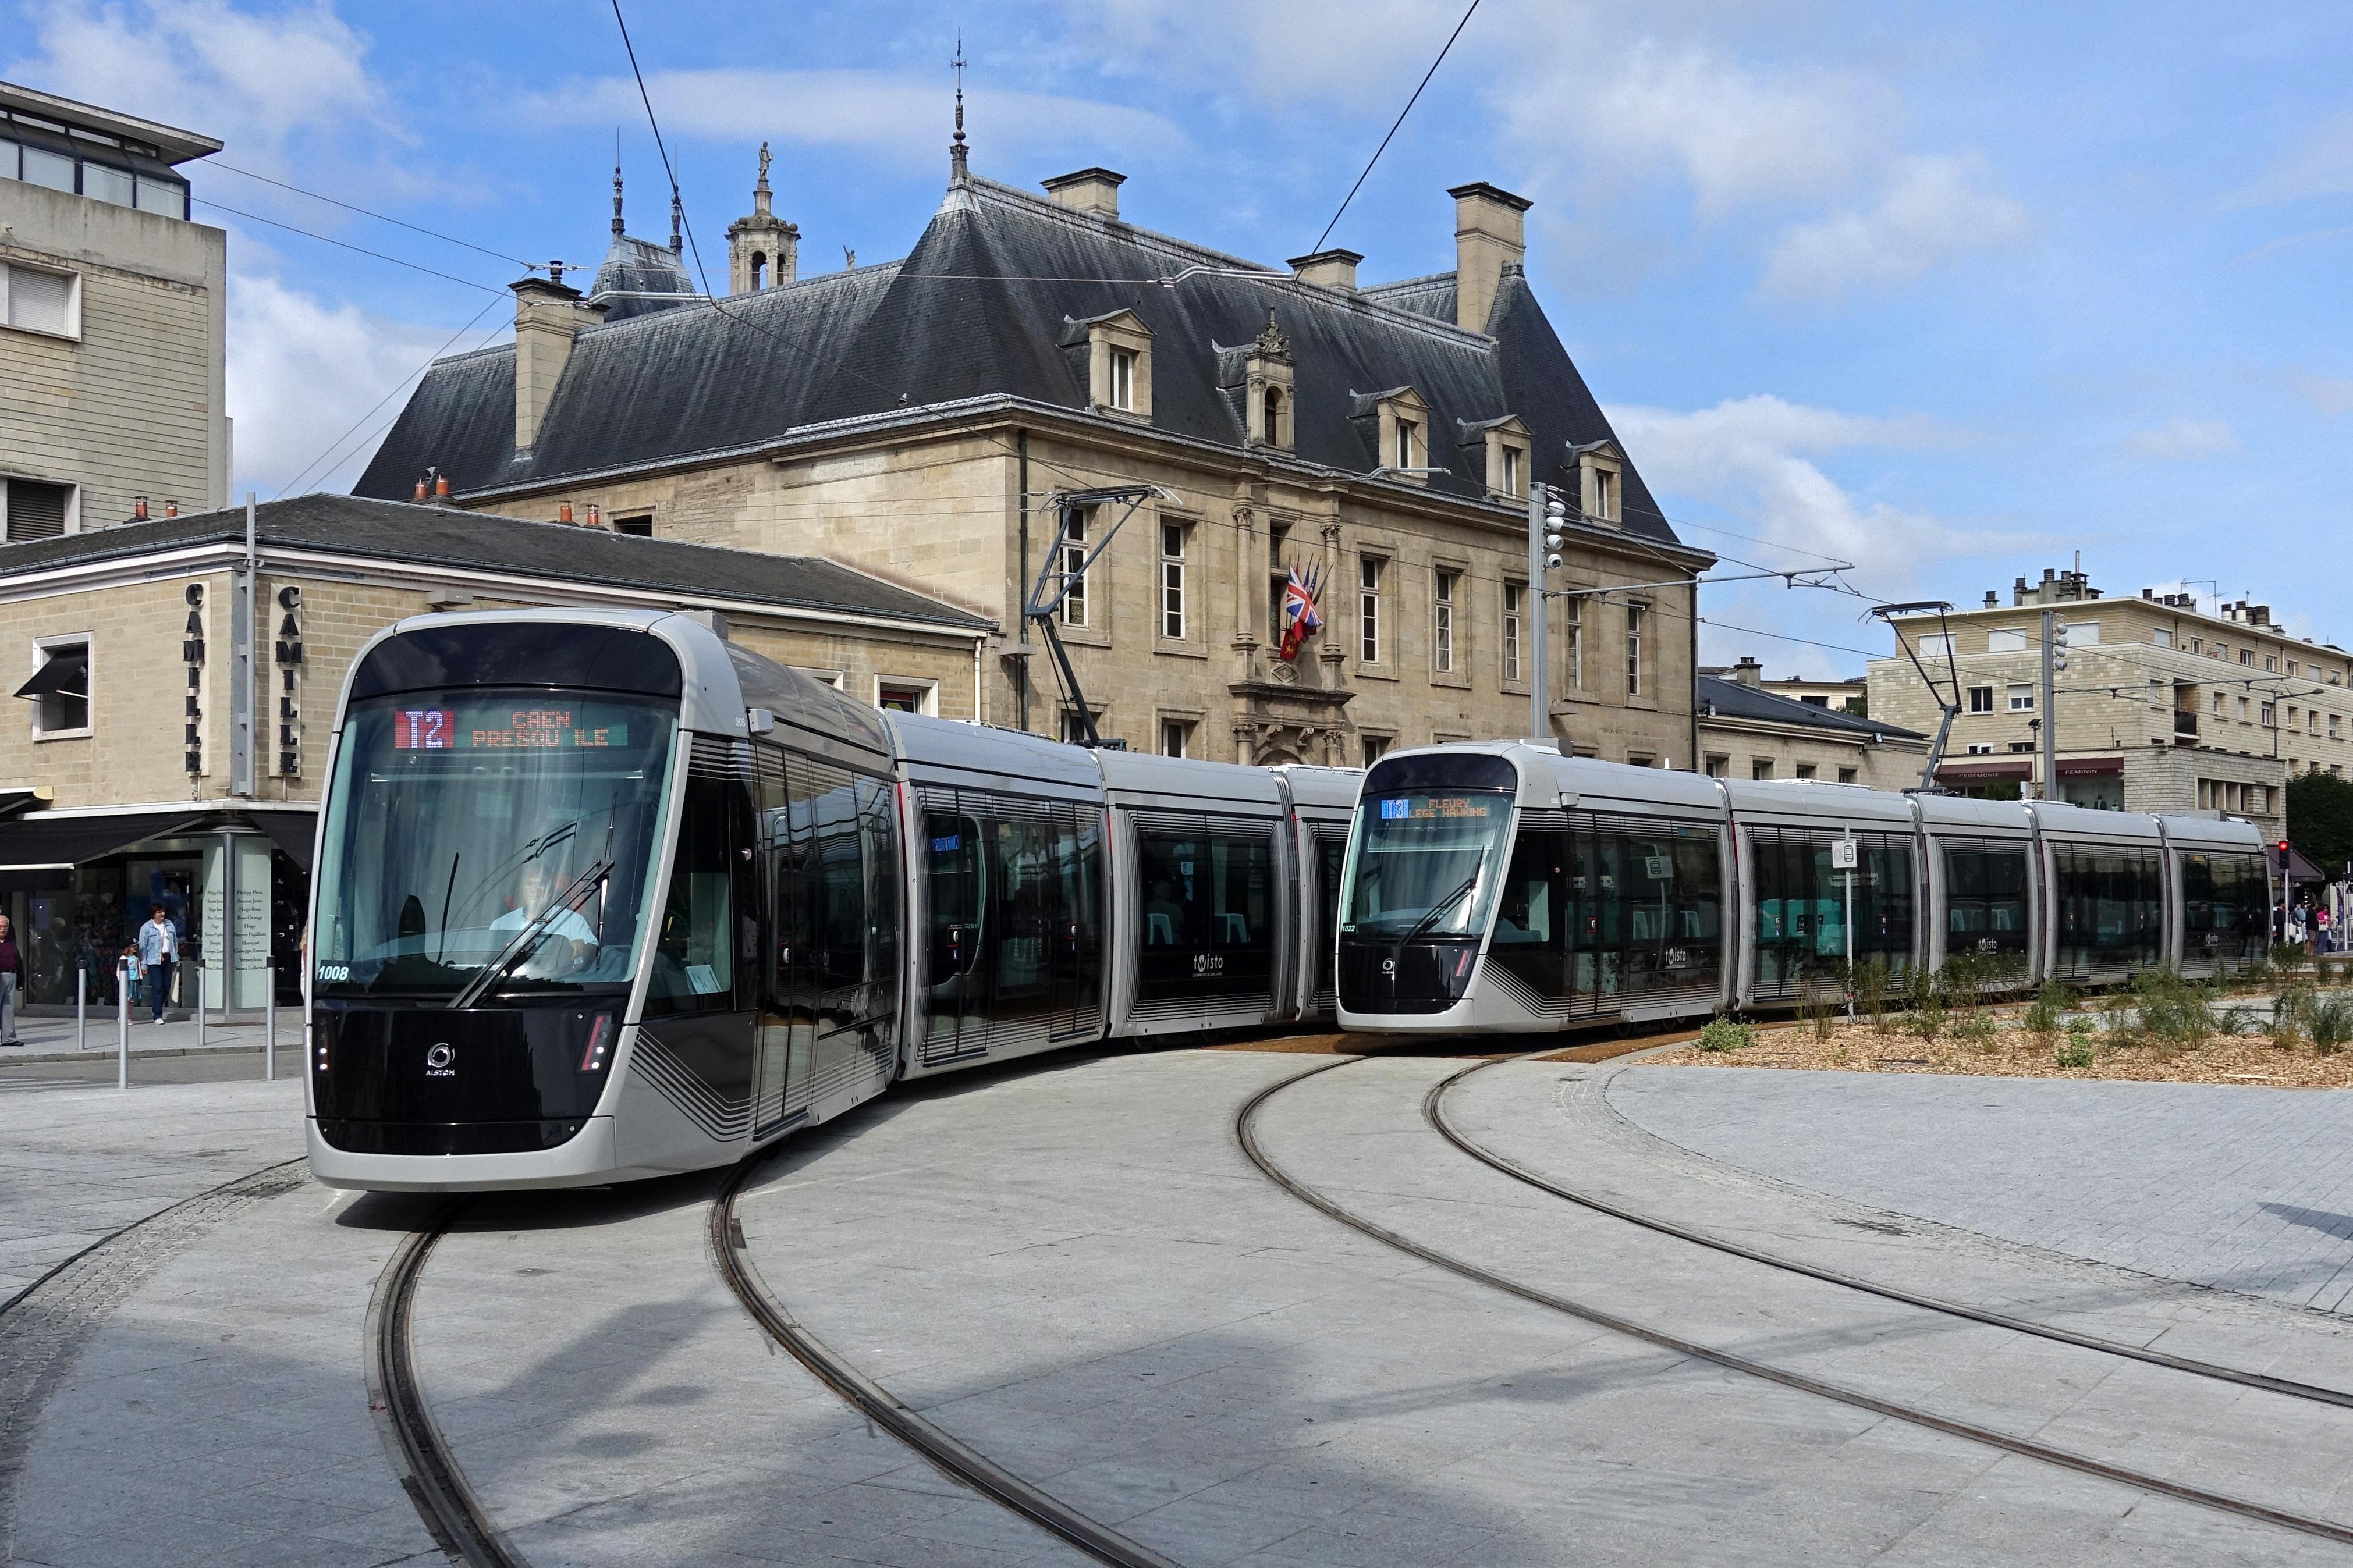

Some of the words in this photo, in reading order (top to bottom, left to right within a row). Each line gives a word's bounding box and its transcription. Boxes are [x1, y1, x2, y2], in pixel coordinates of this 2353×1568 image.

[183, 583, 205, 773] CAMILLE
[275, 586, 303, 773] CAMILLE
[512, 712, 570, 728] CAEN
[406, 710, 443, 749] T2
[574, 728, 608, 746] ILE
[1387, 799, 1404, 819] T3
[1429, 799, 1470, 808] FLEURY
[1443, 807, 1486, 817] HAWKING
[1194, 953, 1223, 972] twisto
[1665, 947, 1686, 965] twisto
[318, 966, 349, 980] 1008
